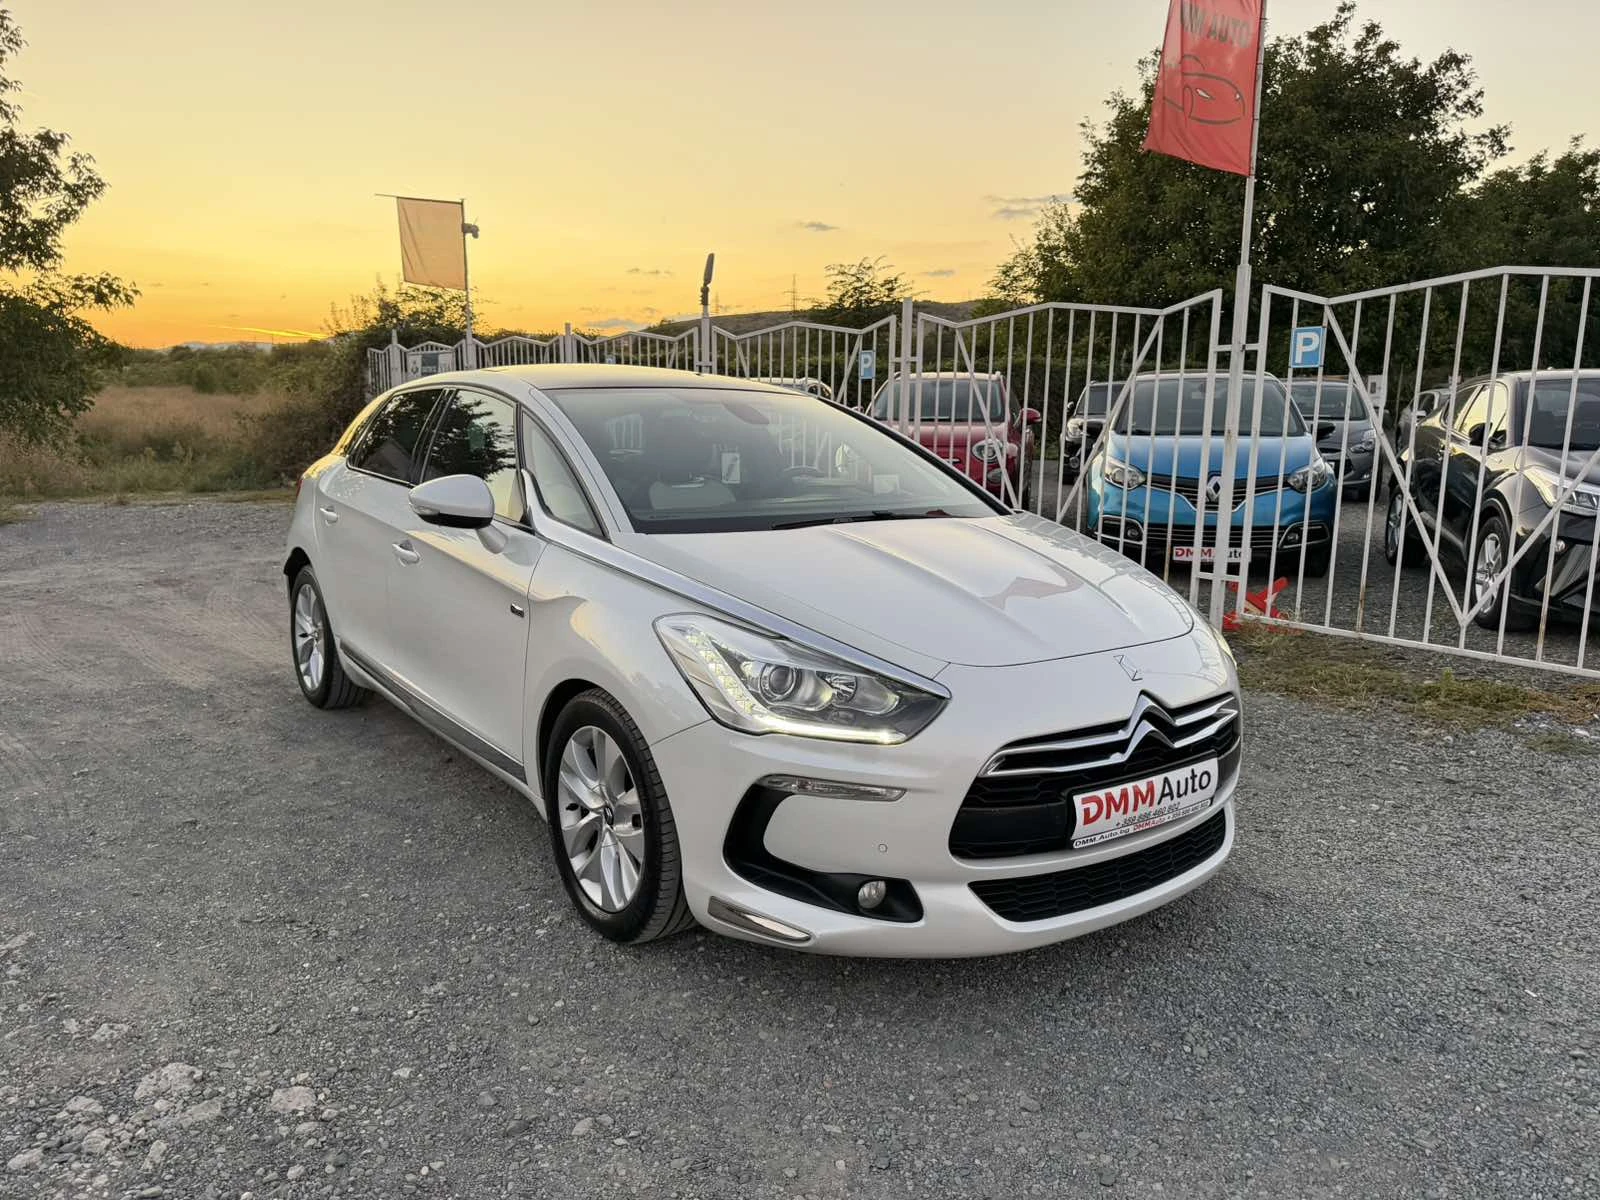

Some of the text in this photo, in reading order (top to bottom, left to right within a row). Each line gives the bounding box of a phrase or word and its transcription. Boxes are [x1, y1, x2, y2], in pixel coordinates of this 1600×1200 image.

[1206, 14, 1250, 48] AUTO
[1296, 332, 1319, 364] P
[861, 352, 872, 377] P
